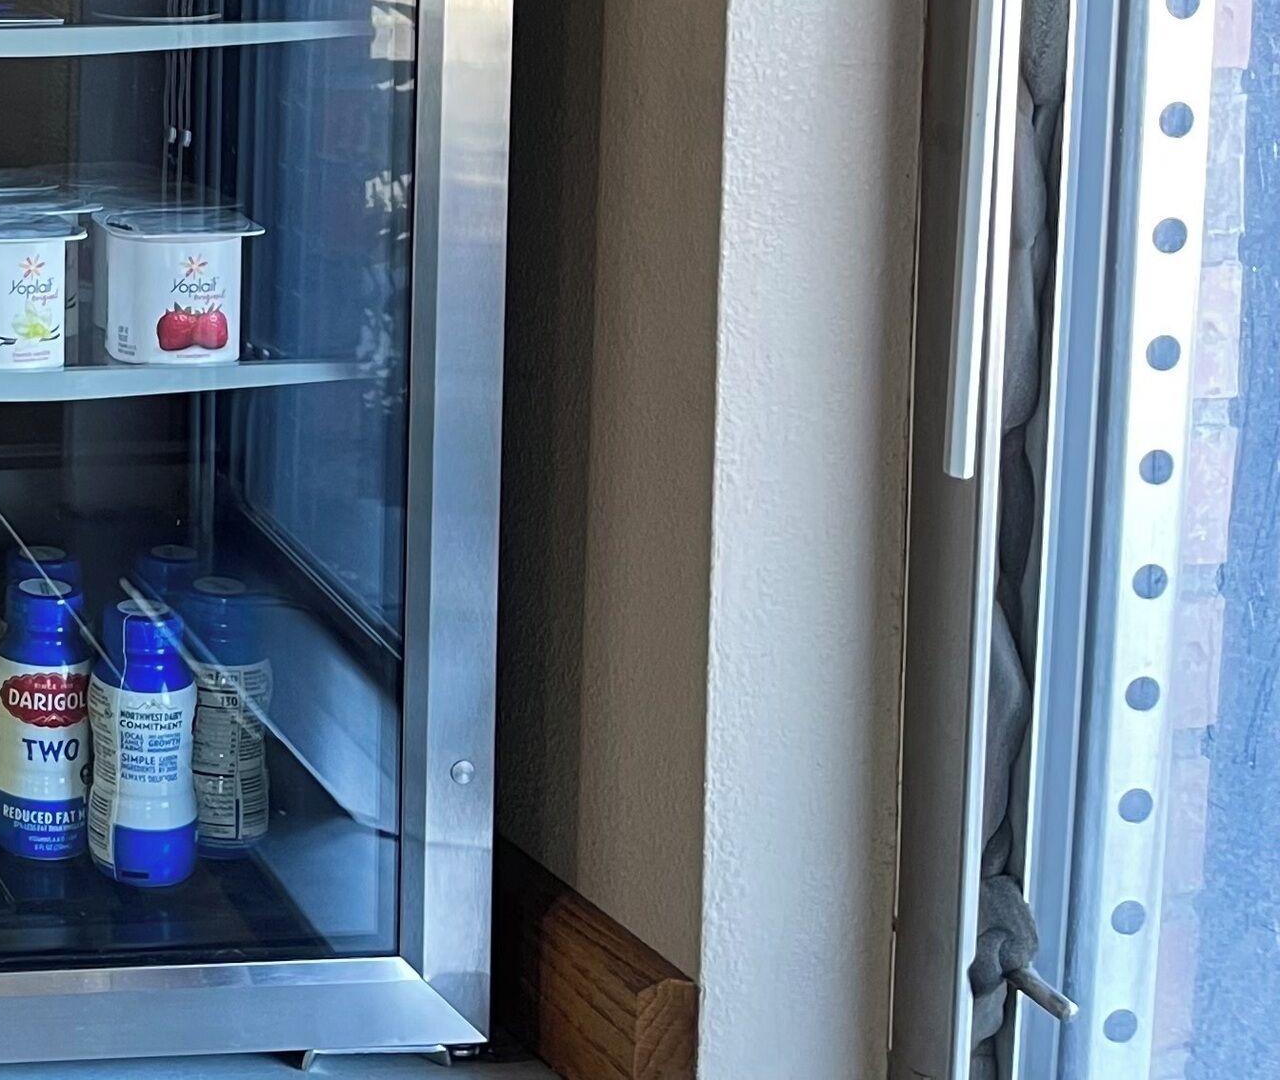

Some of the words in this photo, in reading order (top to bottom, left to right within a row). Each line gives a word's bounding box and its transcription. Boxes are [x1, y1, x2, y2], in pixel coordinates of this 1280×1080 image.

[8, 278, 53, 299] Yoplait
[171, 277, 216, 298] Yoplait
[8, 688, 87, 711] DARIGOL
[119, 719, 183, 731] COMMITMENT
[22, 738, 80, 762] TWO
[121, 753, 156, 766] SIMPLE
[2, 803, 53, 825] REDUCED
[55, 810, 76, 825] FAT
